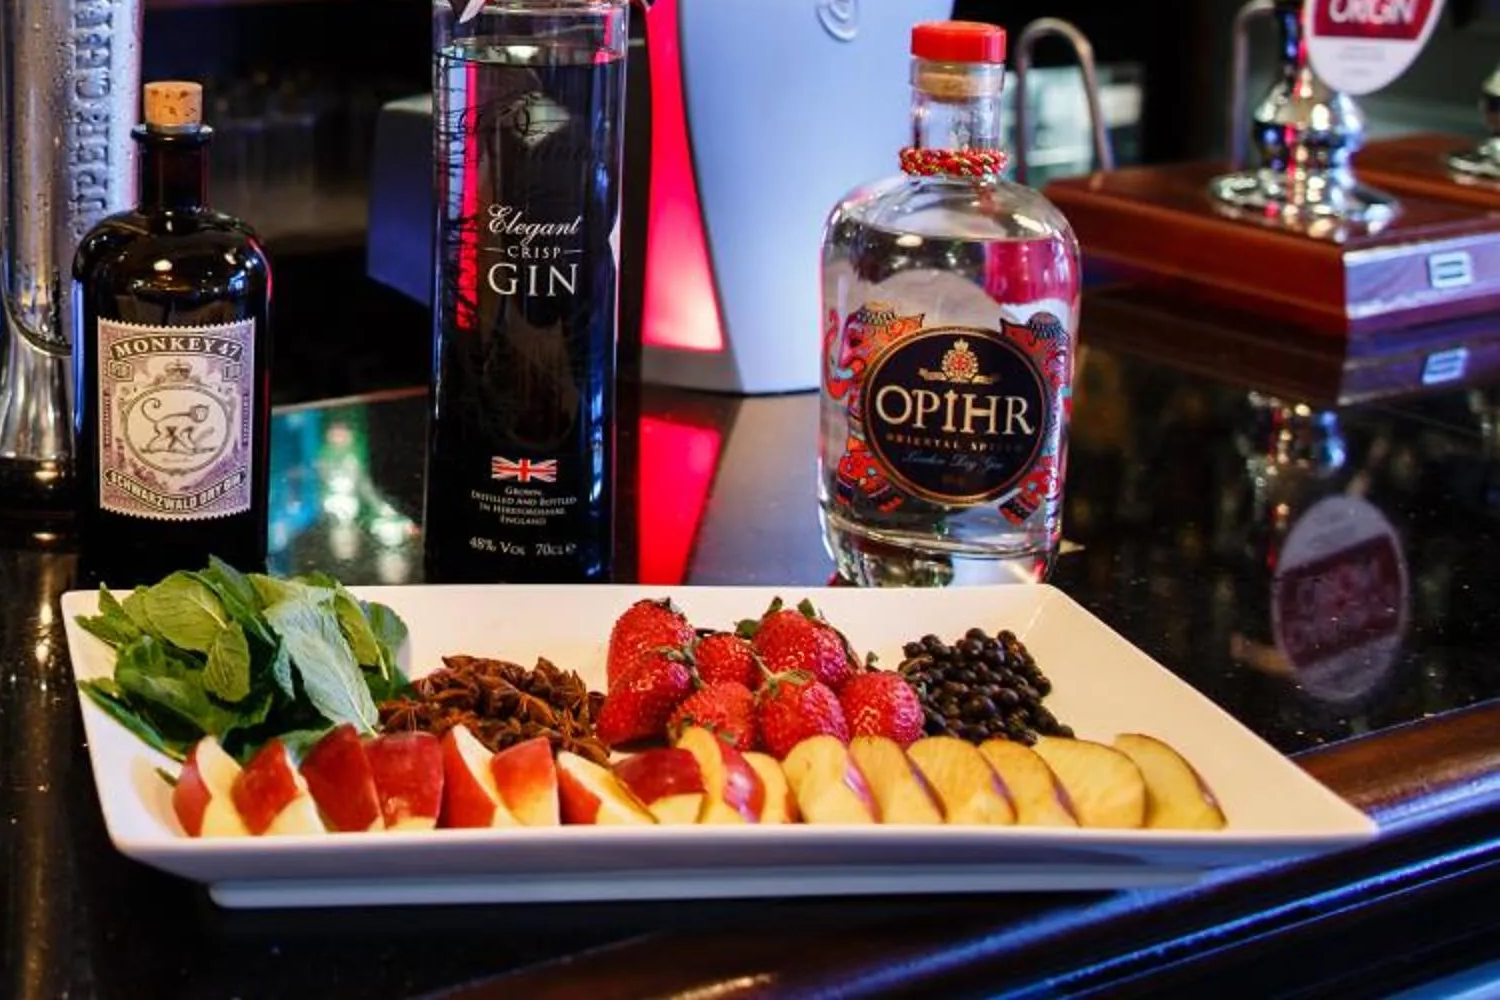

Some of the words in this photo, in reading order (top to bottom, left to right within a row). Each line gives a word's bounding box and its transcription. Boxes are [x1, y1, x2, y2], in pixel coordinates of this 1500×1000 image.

[487, 203, 583, 249] Elegant
[507, 245, 561, 259] CRISP
[487, 262, 579, 298] GIN
[114, 335, 216, 359] MONKEY
[217, 341, 240, 357] 47
[875, 384, 1035, 436] OPIHR
[886, 433, 960, 449] ORIENTAL
[110, 472, 196, 510] SCHWARZWALD
[198, 485, 224, 504] DRY
[471, 489, 515, 505] DISTILLED
[515, 497, 537, 506] AND
[539, 497, 577, 506] BOTTLED
[479, 502, 491, 512] IN
[500, 514, 547, 526] ENGLAND
